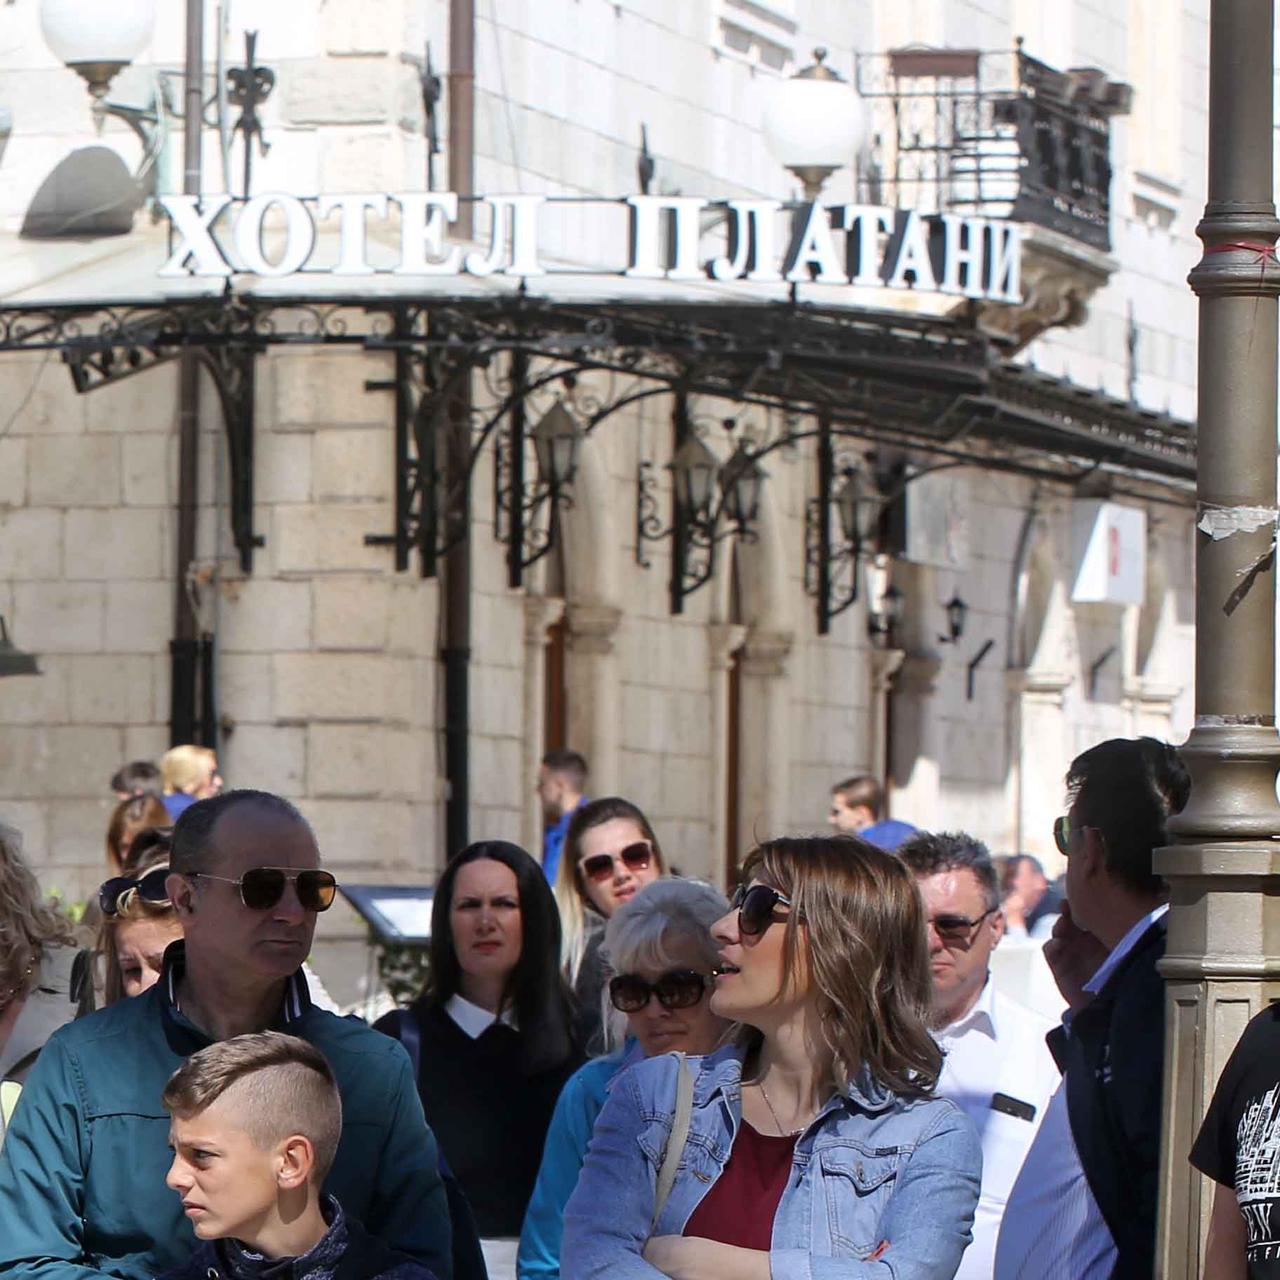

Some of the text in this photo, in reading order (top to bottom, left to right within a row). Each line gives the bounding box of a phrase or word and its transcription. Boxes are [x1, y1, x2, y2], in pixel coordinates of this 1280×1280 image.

[157, 192, 1024, 304] ХОТЕЛ ПЛАТАНИ
[1239, 1203, 1274, 1243] EW
